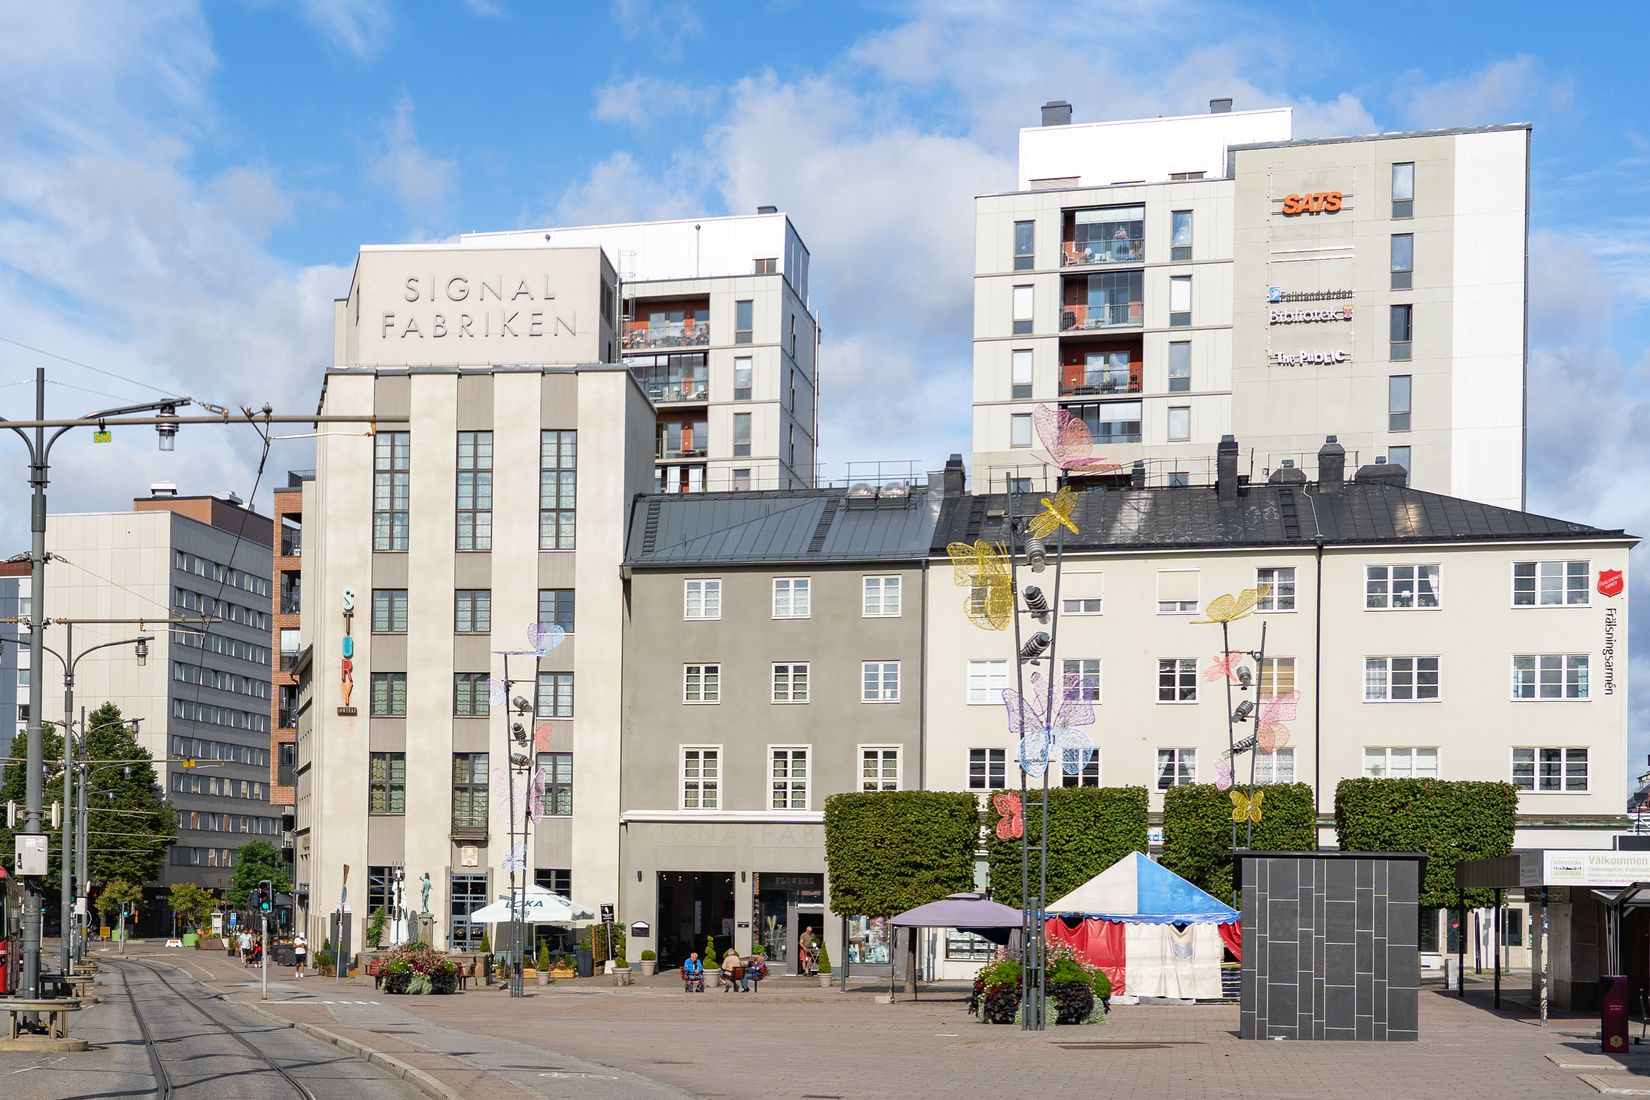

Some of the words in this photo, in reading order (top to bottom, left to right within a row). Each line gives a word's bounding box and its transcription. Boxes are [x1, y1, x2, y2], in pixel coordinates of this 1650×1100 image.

[1282, 191, 1342, 214] SATS
[403, 273, 556, 302] SIGNAL
[382, 310, 577, 338] FABRIKEN
[1270, 307, 1339, 323] Bibliotek
[341, 586, 354, 707] STORY
[1602, 607, 1617, 696] Frälsningsarmén
[1588, 855, 1649, 865] Välkommen
[775, 877, 815, 885] FLOWERS
